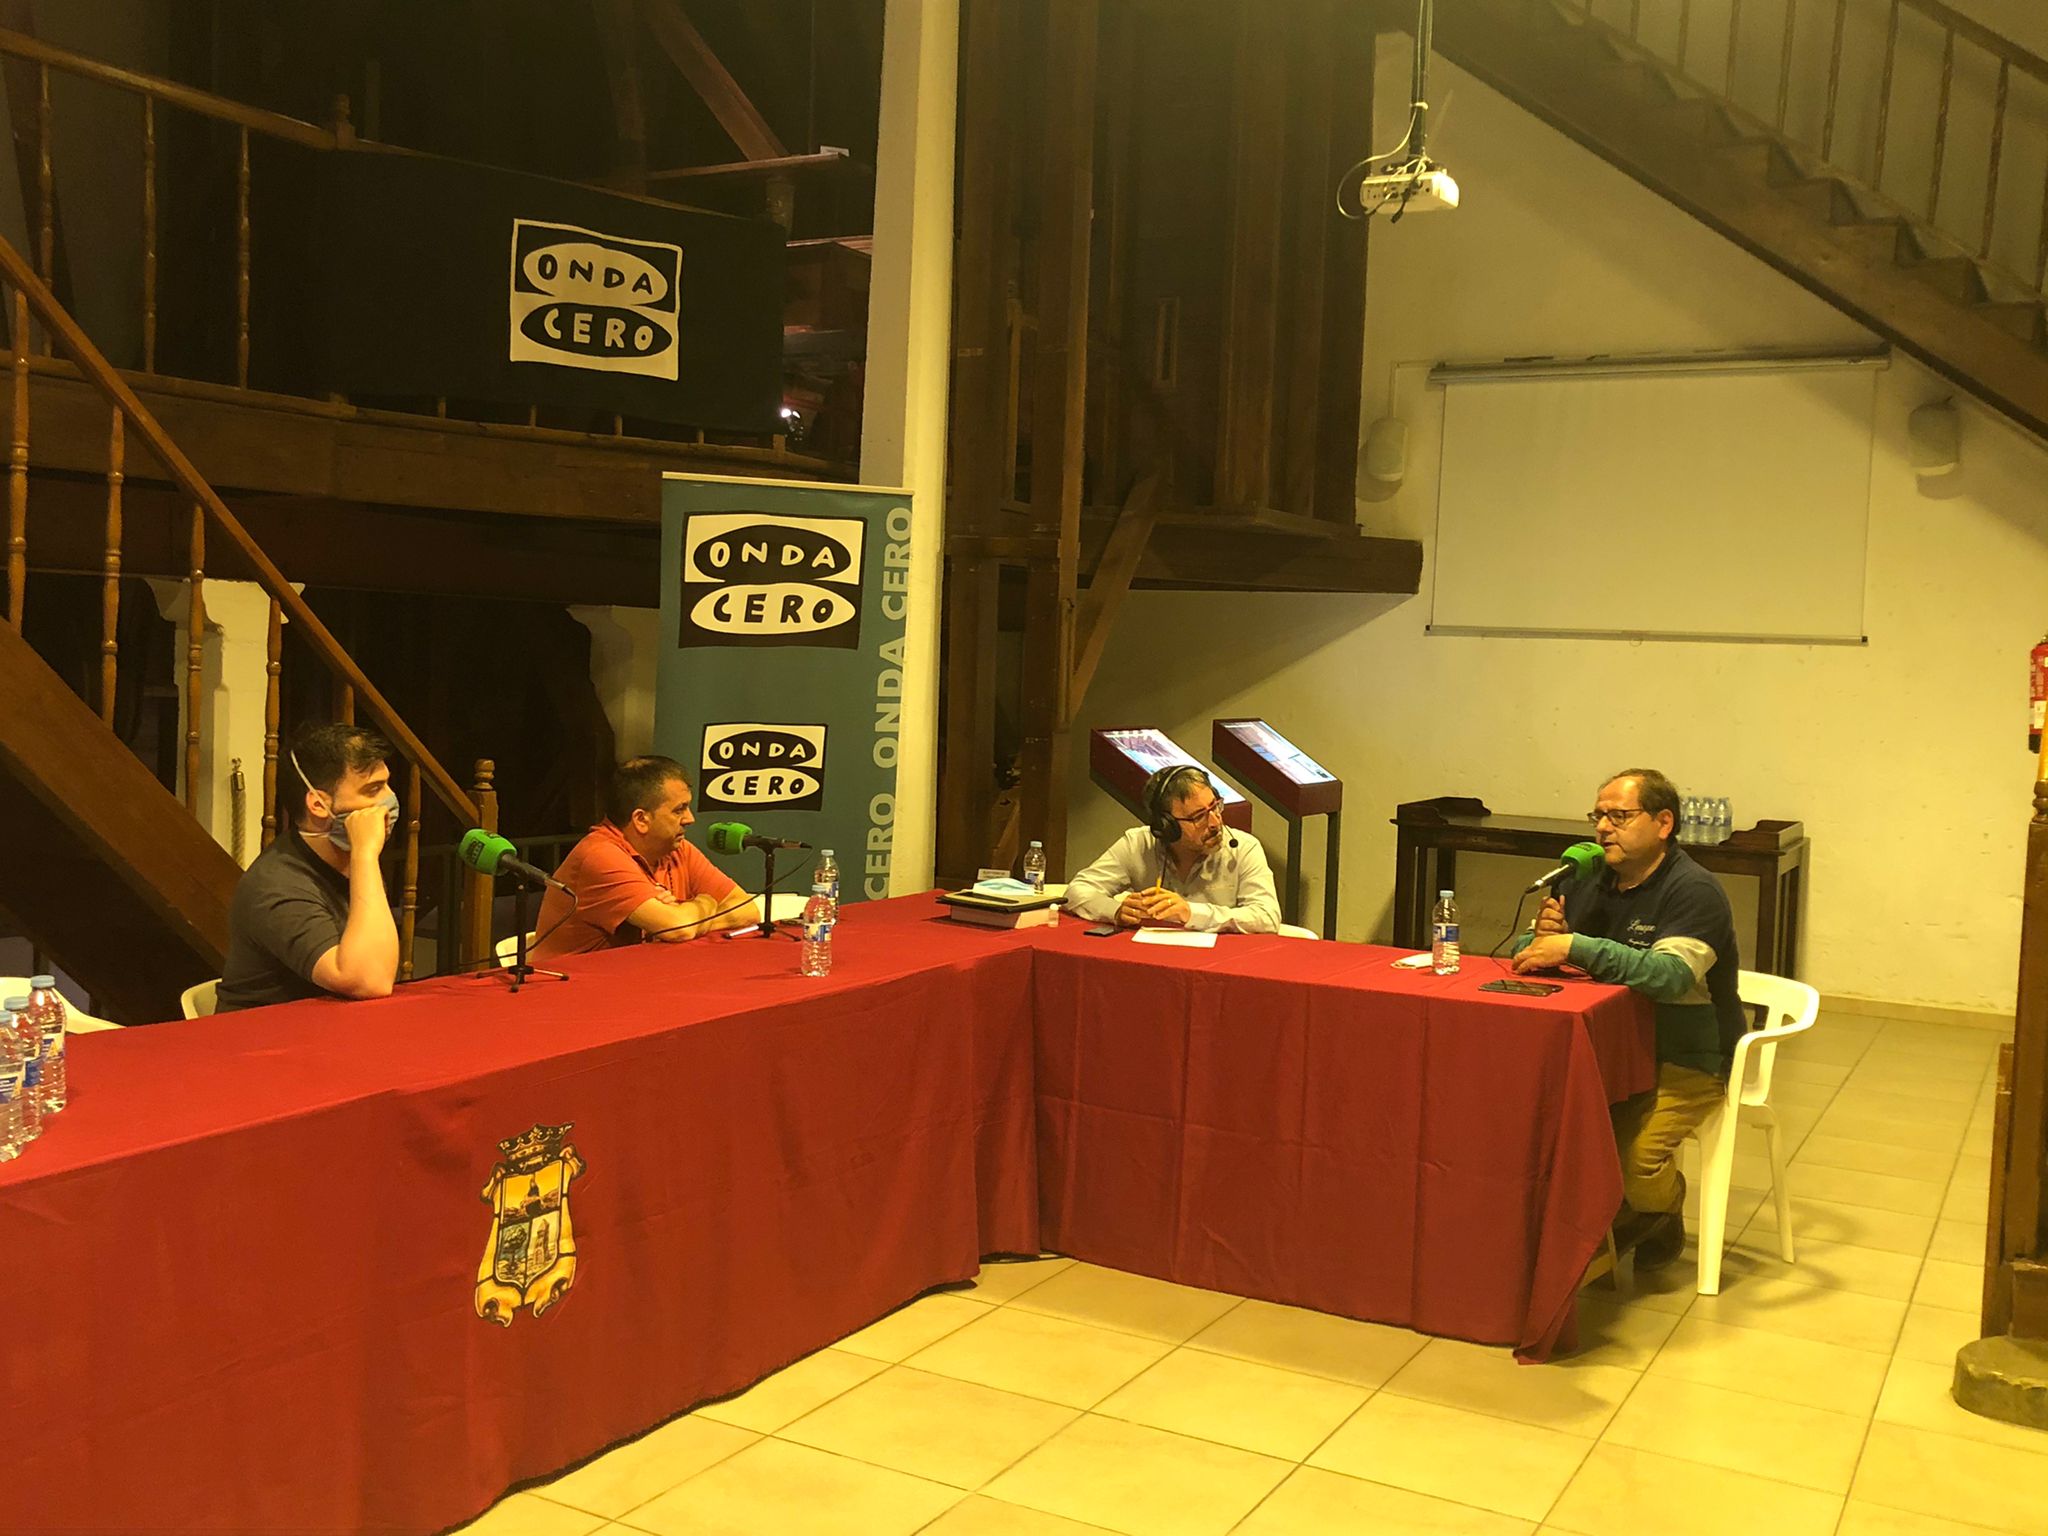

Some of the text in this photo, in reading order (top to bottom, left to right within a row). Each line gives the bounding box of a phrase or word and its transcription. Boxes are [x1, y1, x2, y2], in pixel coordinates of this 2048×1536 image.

[537, 253, 653, 295] ONDA
[543, 307, 654, 351] CERO
[709, 541, 836, 568] ONDA
[712, 593, 834, 624] CERO
[864, 507, 913, 900] CERO ONDA CERO
[719, 742, 806, 759] ONDA
[722, 775, 805, 795] CERO
